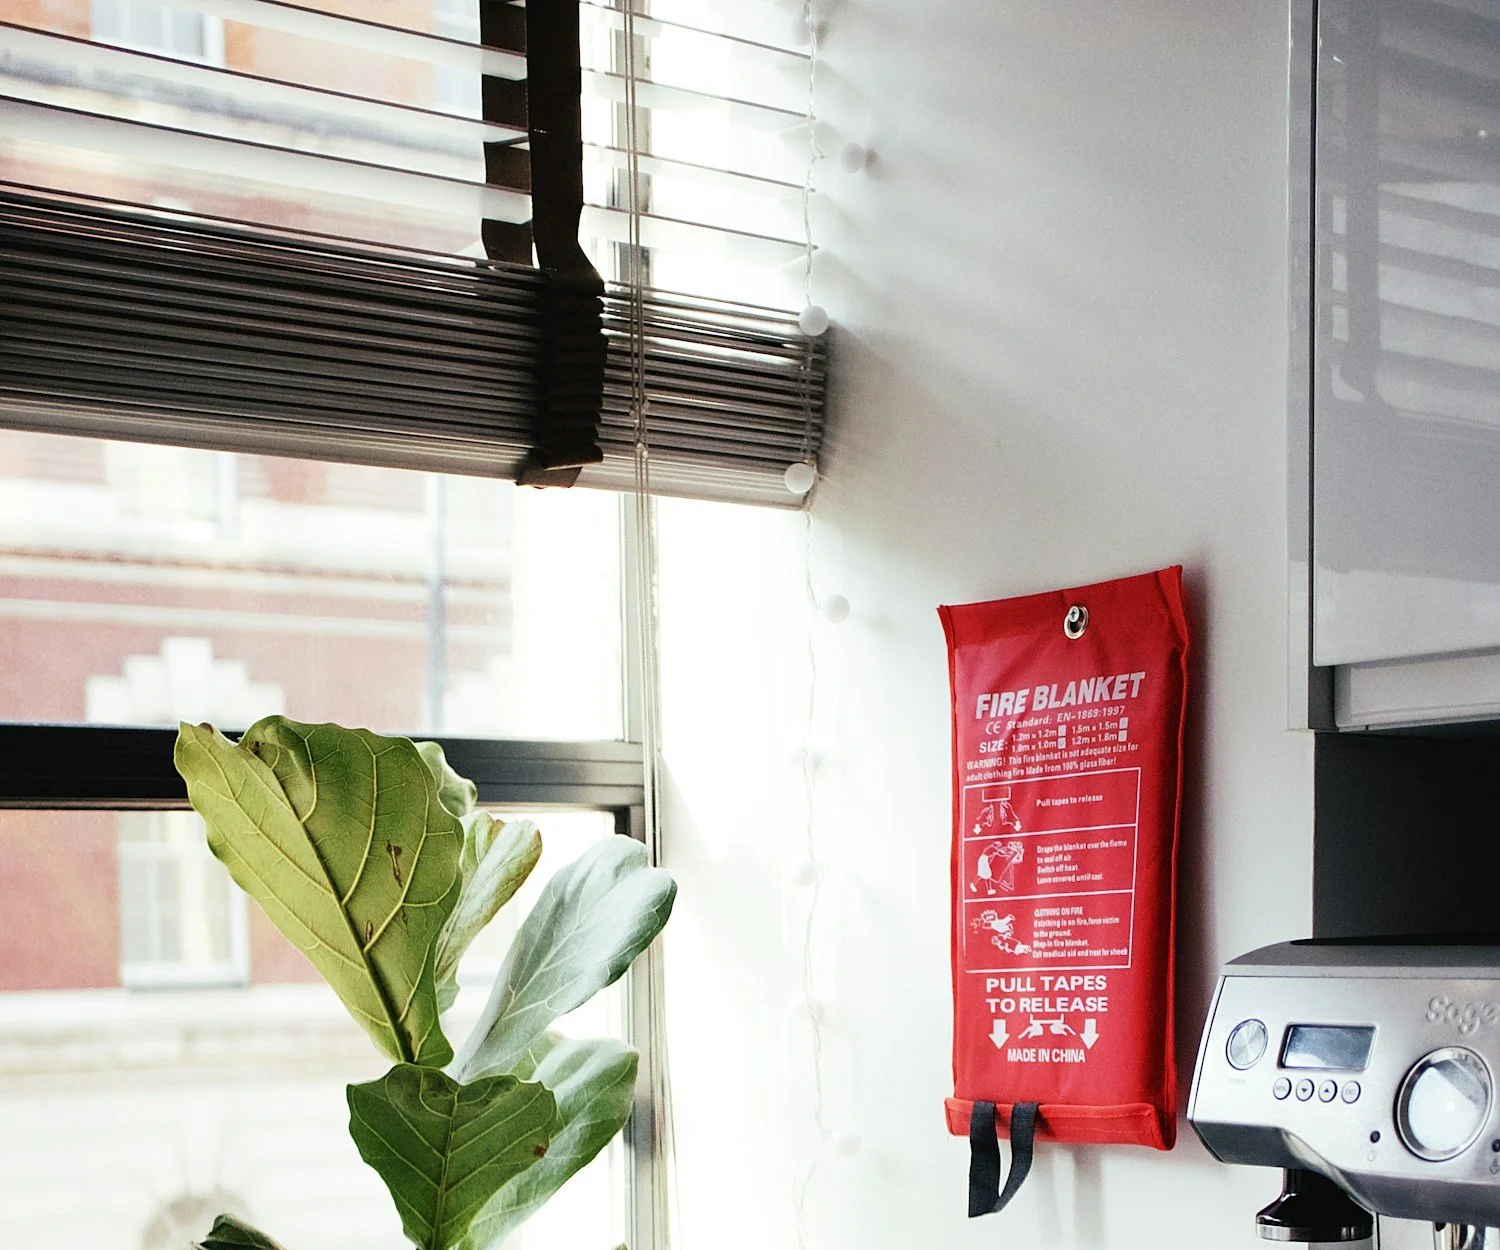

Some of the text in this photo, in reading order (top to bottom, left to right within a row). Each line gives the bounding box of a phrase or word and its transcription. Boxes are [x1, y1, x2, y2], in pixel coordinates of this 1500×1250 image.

[976, 671, 1146, 719] FIRE BLANKET
[986, 705, 1125, 735] CE Standard: EN-1869:1997
[1072, 725, 1090, 734] 1.5m
[1099, 721, 1118, 731] 1.5m
[1012, 732, 1030, 742] 1.2m
[1038, 729, 1057, 739] 1.2m
[1072, 736, 1090, 745] 1.2m
[979, 739, 1008, 753] SIZE:
[1012, 744, 1030, 753] 1.0m
[1038, 740, 1057, 750] 1.0m
[967, 742, 1139, 770] WARNING! This fire blanket is not adequate size for
[1026, 766, 1043, 775] Made
[1045, 764, 1061, 773] from
[1063, 761, 1079, 770] 100%
[1080, 760, 1097, 771] glass
[1098, 757, 1117, 766] fiber!
[1036, 799, 1051, 807] Pull
[1051, 798, 1069, 806] tapes
[1078, 794, 1103, 803] release
[1063, 842, 1087, 851] blanket
[1100, 840, 1109, 848] the
[1110, 839, 1127, 848] flame
[1055, 854, 1063, 862] off
[1056, 864, 1064, 872] off
[1052, 874, 1075, 883] covered
[1076, 873, 1091, 882] until
[1061, 907, 1070, 916] ON
[1071, 906, 1083, 915] FIRE
[1061, 918, 1067, 926] is
[1049, 929, 1072, 939] ground.
[1053, 939, 1064, 947] fire
[1043, 950, 1066, 958] medical
[1067, 949, 1076, 957] aid
[1077, 949, 1089, 957] and
[1110, 947, 1128, 956] shock
[986, 975, 1107, 993] PULL TAPES
[985, 996, 1109, 1013] TO RELEASE
[1007, 1048, 1086, 1063] MADE IN CHINA
